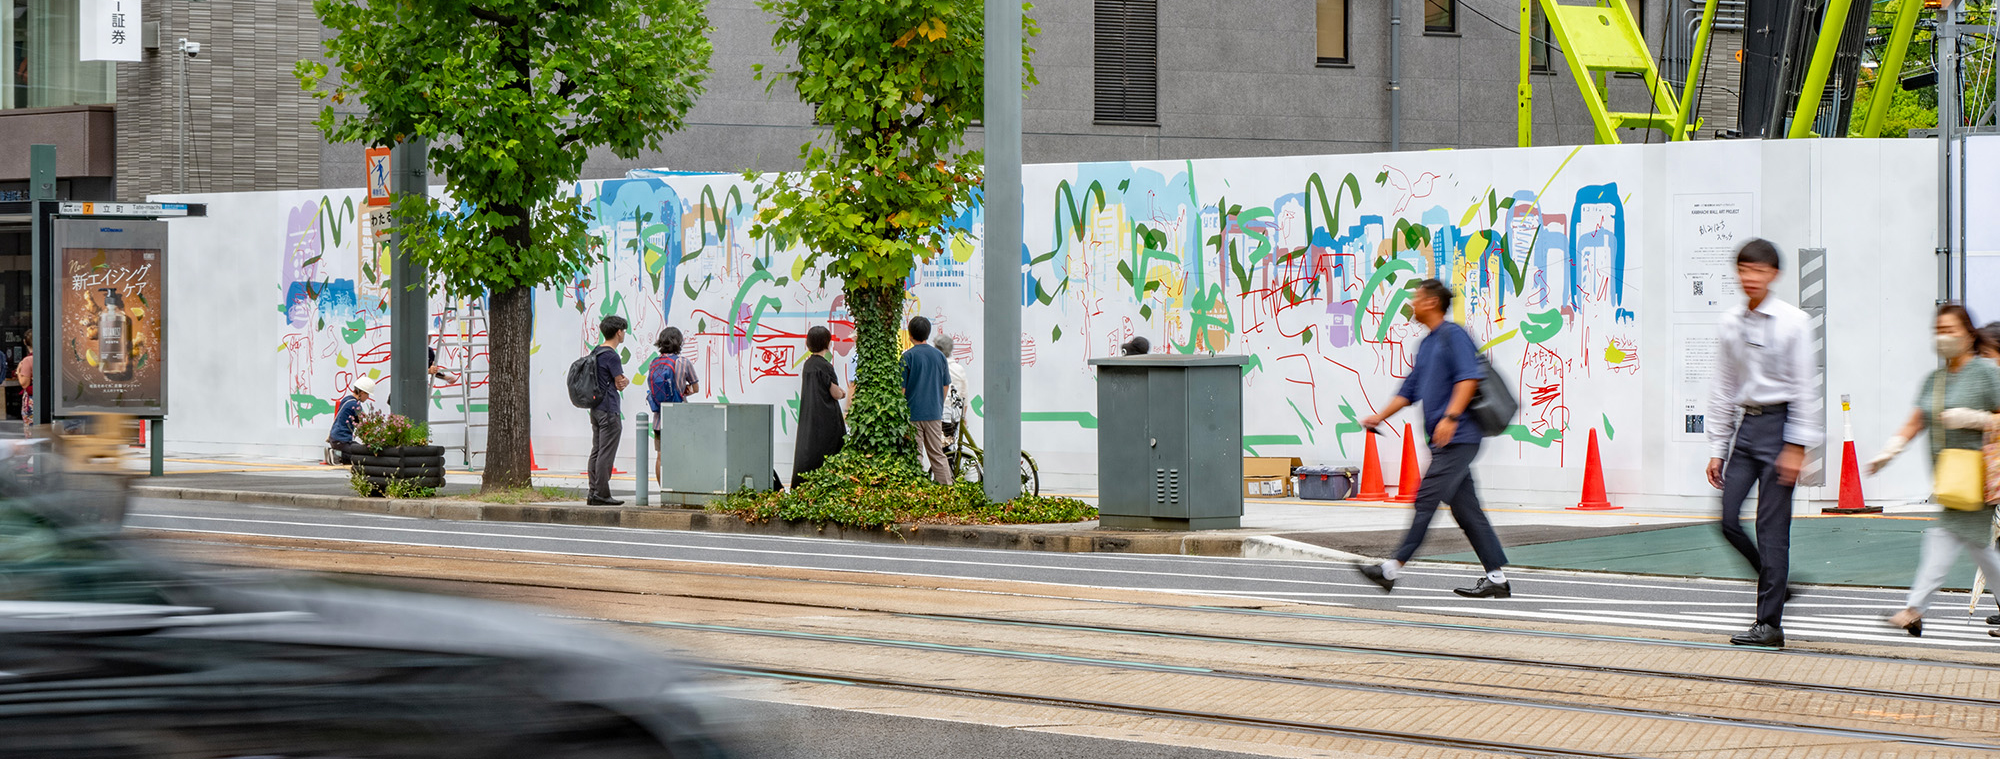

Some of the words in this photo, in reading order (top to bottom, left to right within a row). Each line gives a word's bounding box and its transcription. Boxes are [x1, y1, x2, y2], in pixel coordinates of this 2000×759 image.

[85, 204, 91, 213] 7
[72, 263, 152, 291] 新エイジング
[123, 282, 147, 298] ケア
